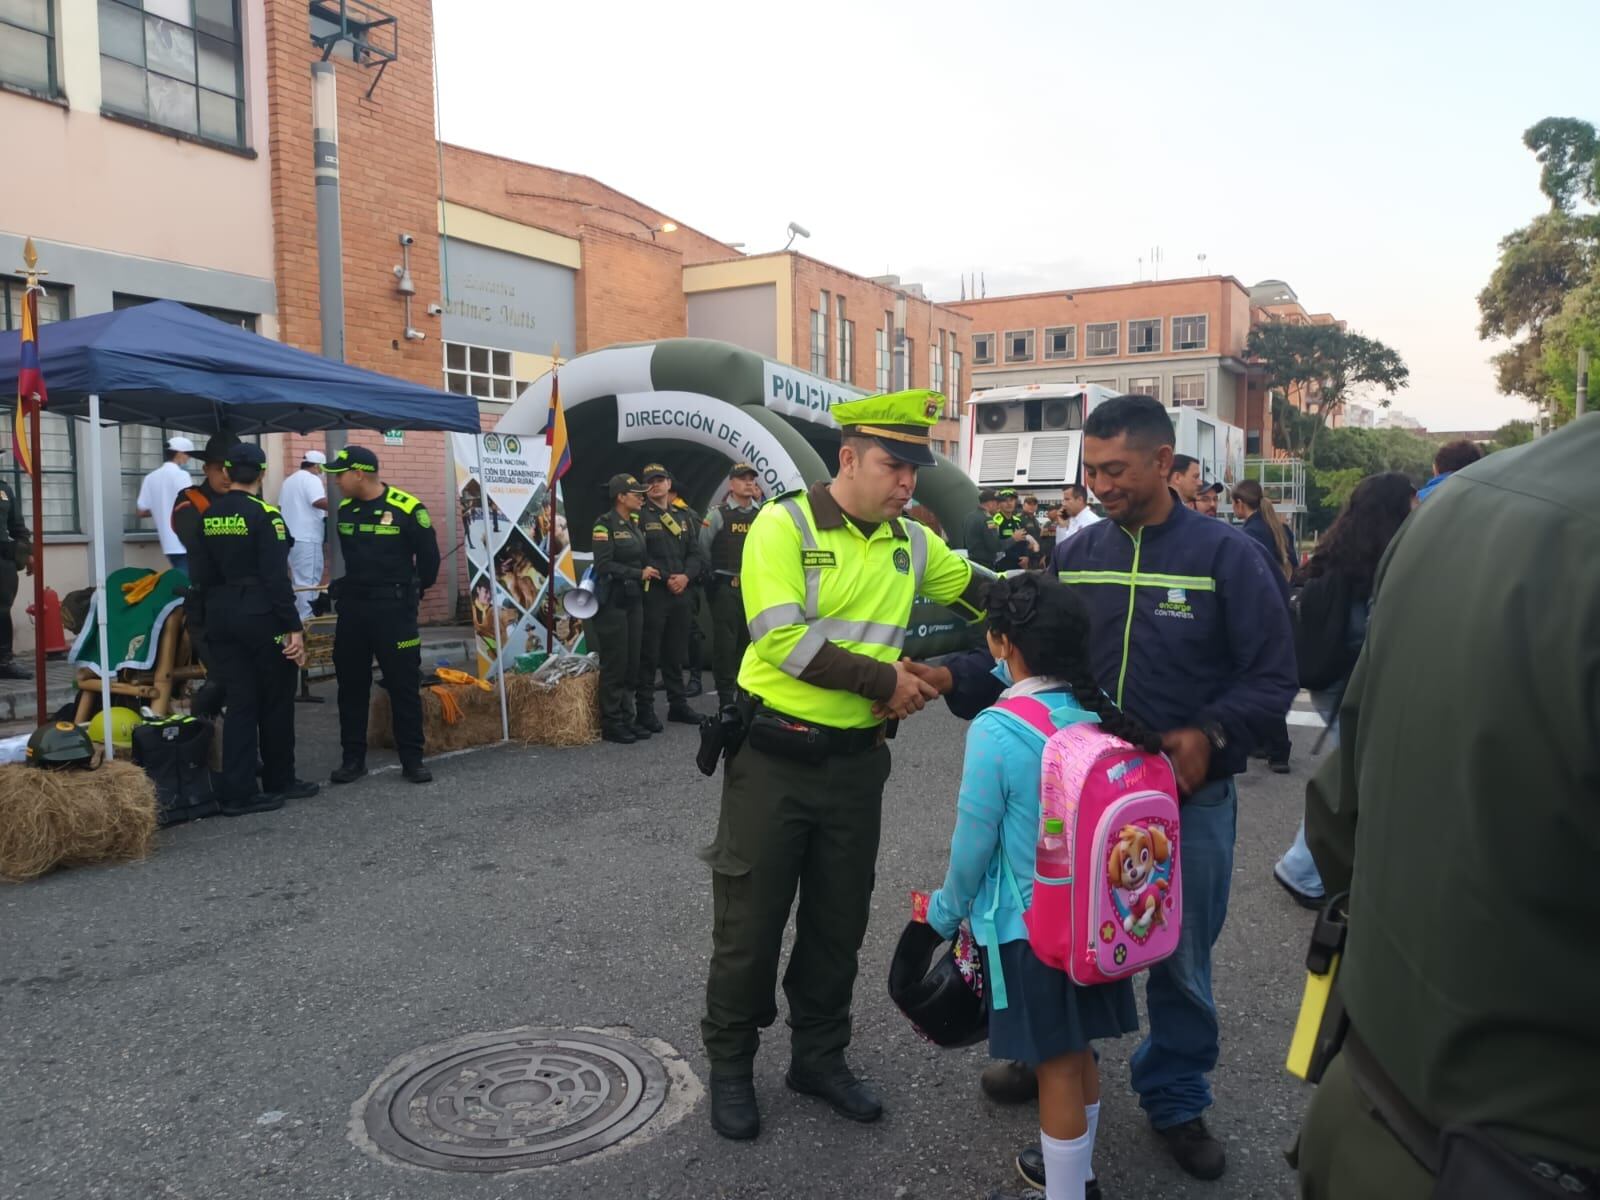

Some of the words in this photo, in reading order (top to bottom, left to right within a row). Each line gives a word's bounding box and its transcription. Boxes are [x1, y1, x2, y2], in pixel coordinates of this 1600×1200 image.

[625, 409, 715, 434] DIRECCIÓN
[718, 423, 742, 448] DE
[499, 468, 507, 476] DE
[203, 513, 246, 529] POLICÍA
